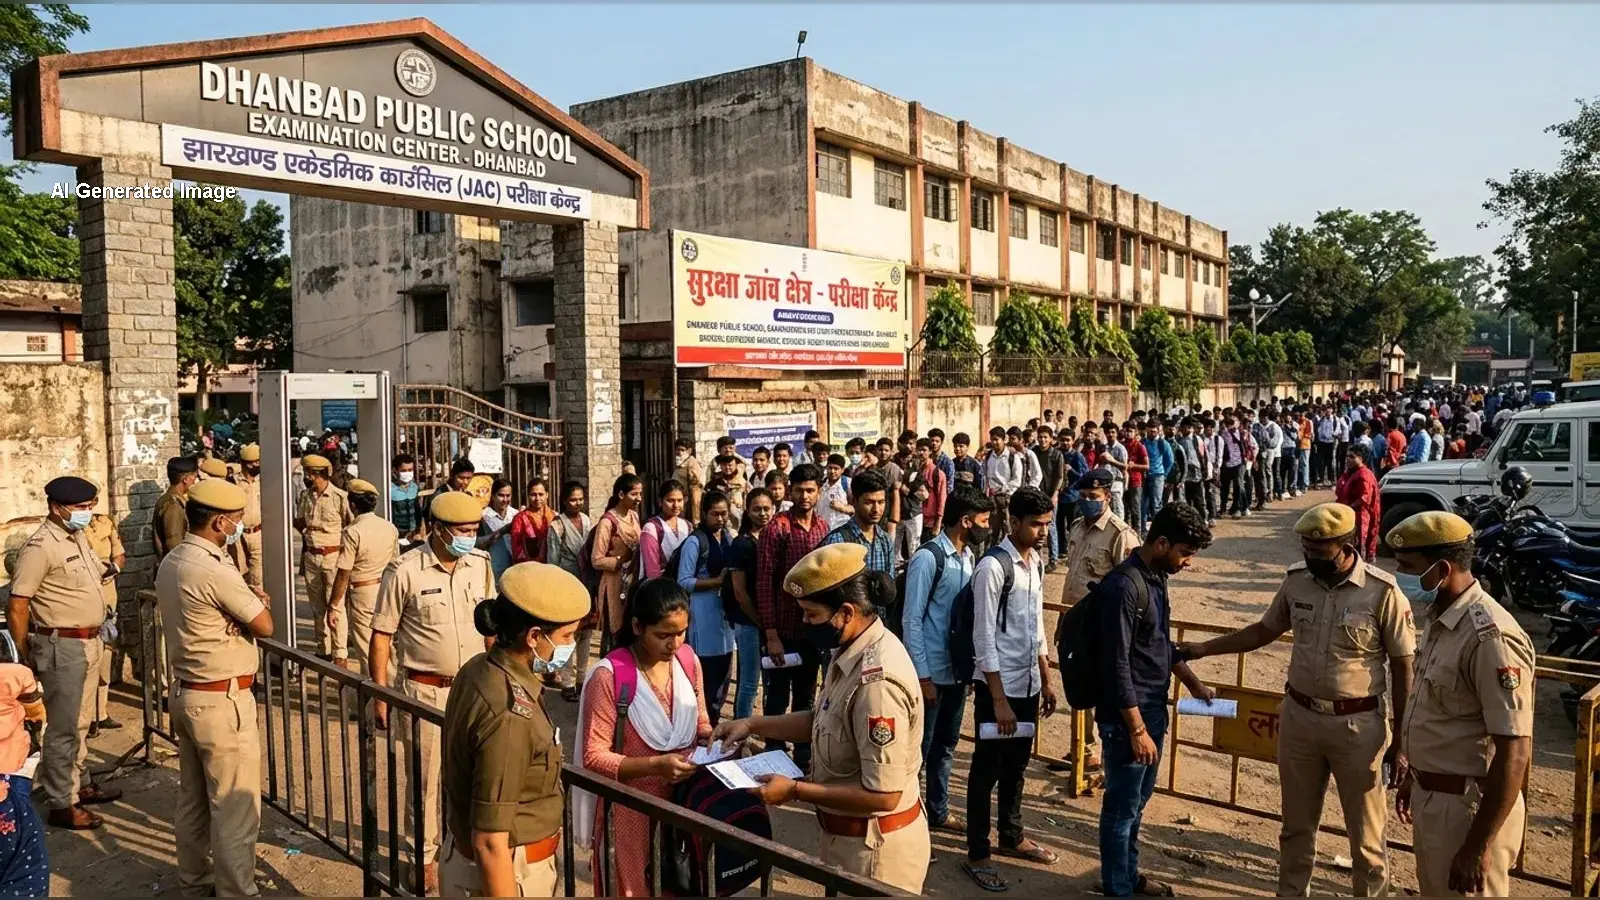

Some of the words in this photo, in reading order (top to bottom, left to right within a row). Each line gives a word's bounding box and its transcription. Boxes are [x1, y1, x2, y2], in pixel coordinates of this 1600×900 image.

[201, 61, 367, 125] DHANBAD
[376, 95, 476, 145] PUBLIC
[483, 117, 577, 165] SCHOOL
[248, 112, 387, 153] EXAMINATION
[392, 136, 460, 165] CENTER
[473, 149, 547, 178] DHANBAD
[182, 137, 278, 171] झारखण्ड
[283, 149, 374, 182] एकेडमिक
[379, 165, 453, 194] काउंसिल
[457, 174, 501, 204] (JAC)
[506, 182, 547, 206] परीक्षा
[550, 187, 582, 213] केन्द्र
[686, 268, 740, 306] सुरक्षा
[745, 268, 781, 302] जांच
[785, 271, 813, 304] क्षेत्र
[828, 277, 870, 309] परीक्षा
[1248, 710, 1279, 739] ल
